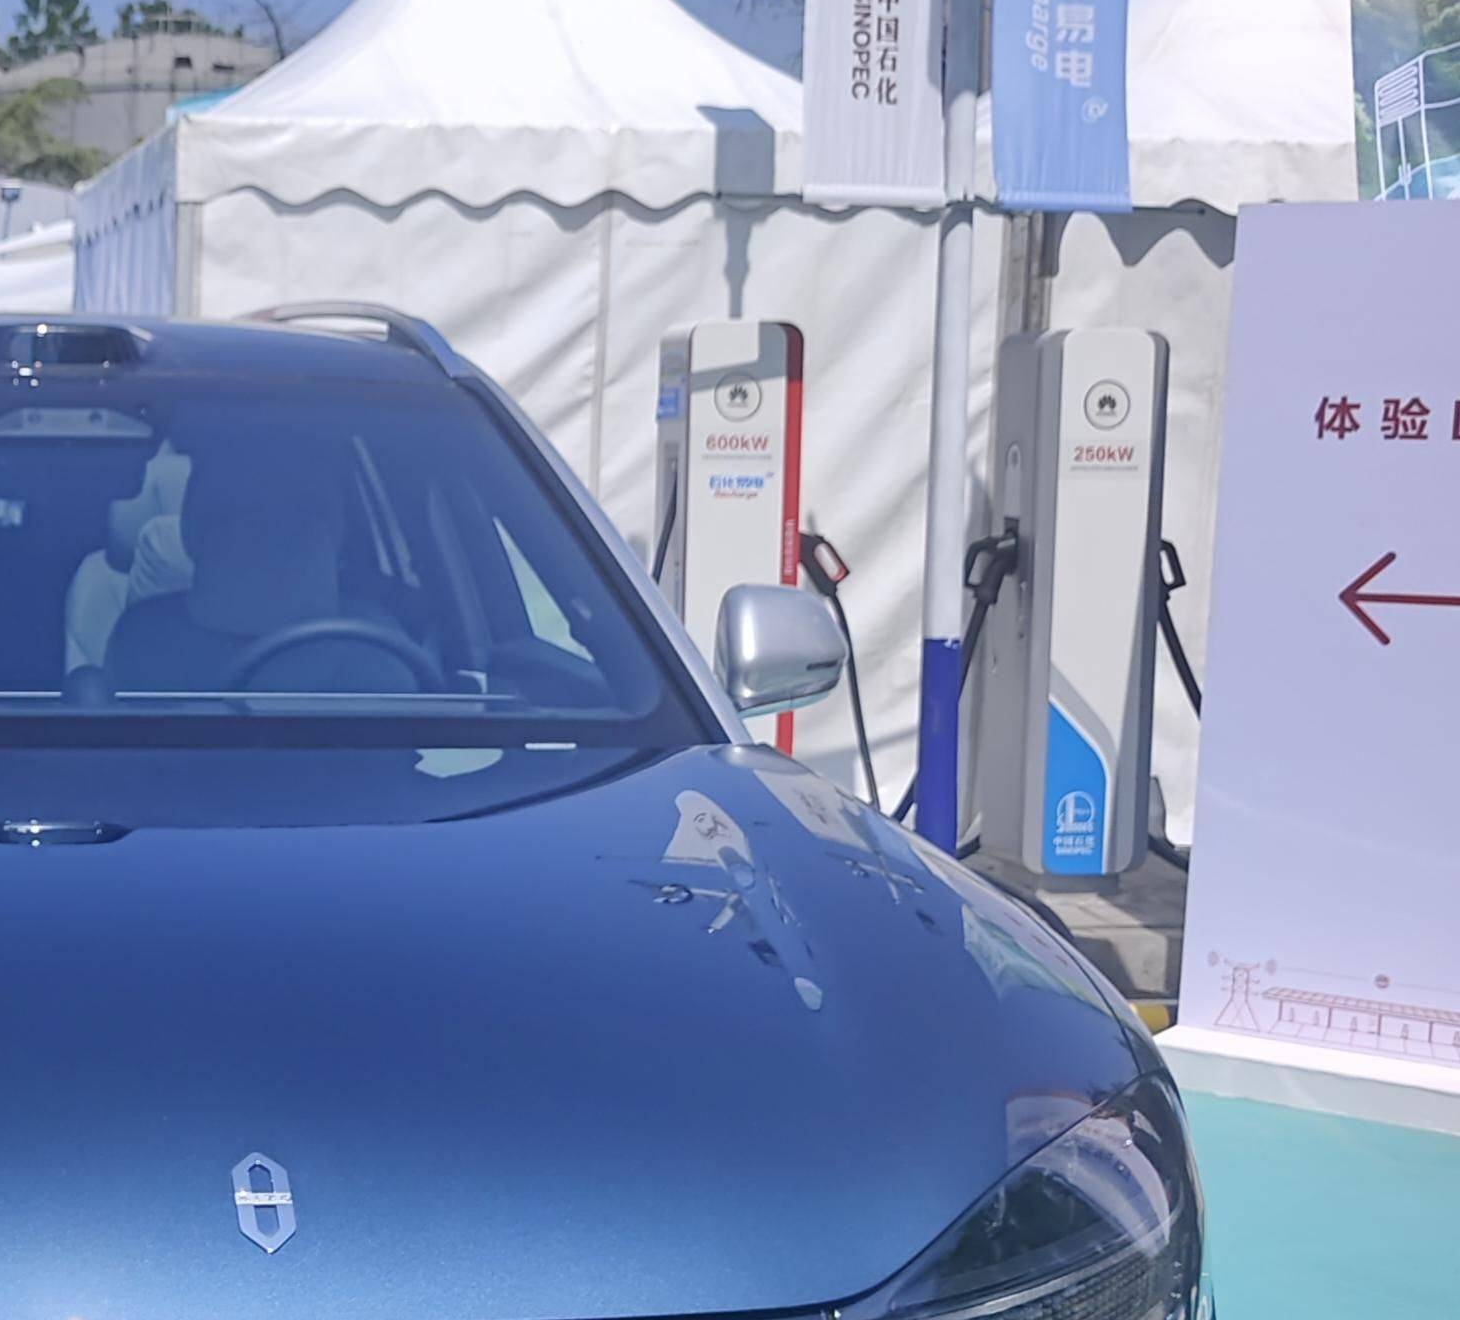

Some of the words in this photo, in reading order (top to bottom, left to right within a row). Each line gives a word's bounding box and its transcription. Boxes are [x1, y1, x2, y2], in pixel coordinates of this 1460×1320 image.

[1314, 395, 1460, 440] 体验
[706, 434, 769, 451] 600kW
[1073, 445, 1134, 462] 250kW
